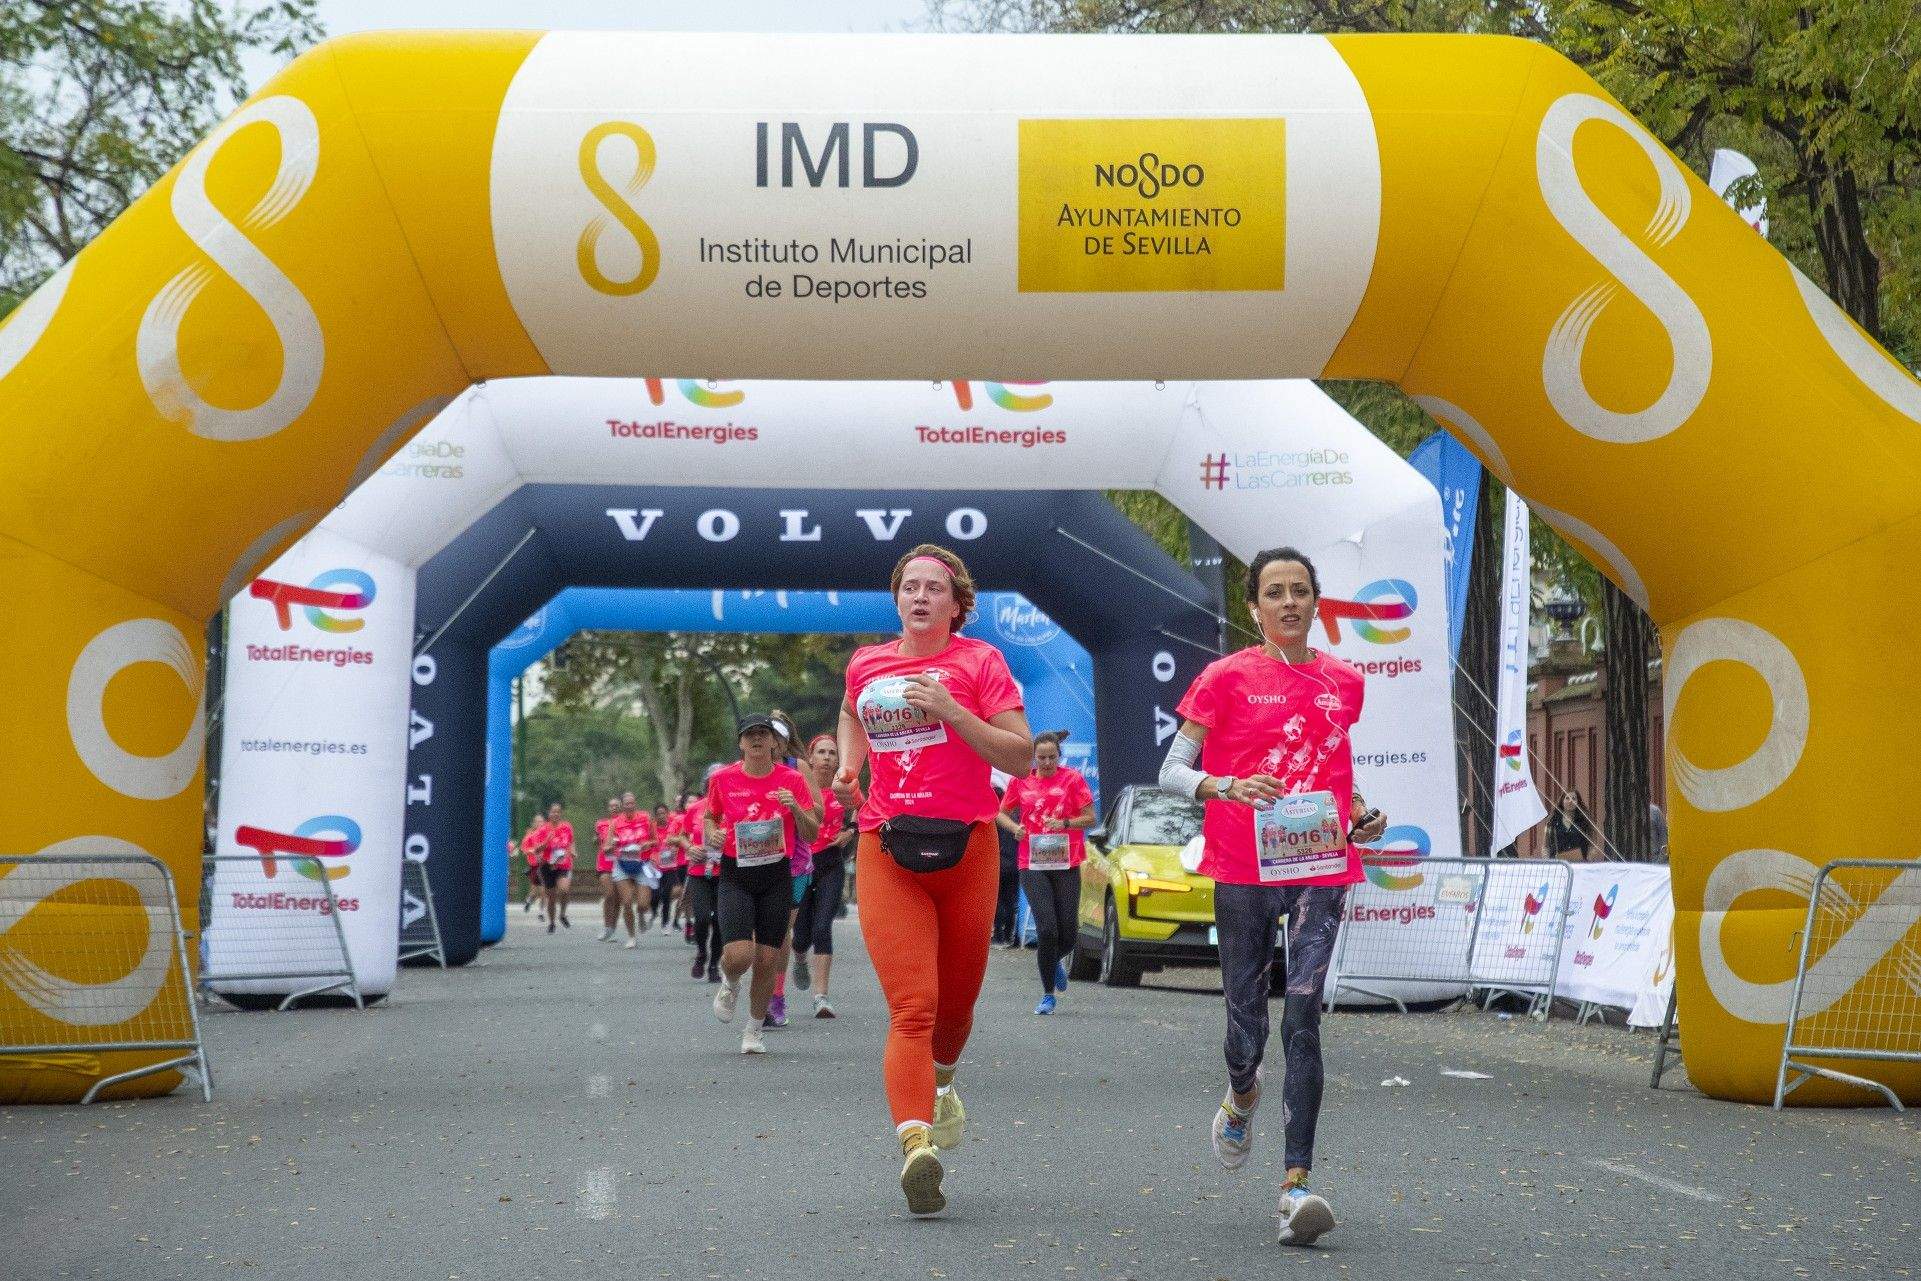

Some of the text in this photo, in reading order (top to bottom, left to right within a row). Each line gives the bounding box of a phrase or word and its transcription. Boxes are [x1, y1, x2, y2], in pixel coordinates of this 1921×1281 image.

[756, 122, 919, 188] IMD
[1057, 203, 1242, 227] AYUNTAMIENTO
[700, 237, 972, 270] Instituto Municipal
[1085, 231, 1212, 255] DE SEVILLA
[745, 274, 927, 303] de Deportes
[606, 419, 759, 447] TotalEnergies
[915, 425, 1067, 448] TotalEnergies
[606, 508, 989, 542] VOLVO
[245, 644, 374, 667] TotalEnergies
[1342, 656, 1423, 678] nergies
[1247, 694, 1287, 704] OYSHO
[241, 739, 368, 755] totalenergies.es
[402, 654, 437, 930] VOLVO
[1287, 829, 1321, 846] 016
[1270, 866, 1300, 877] OYSHO
